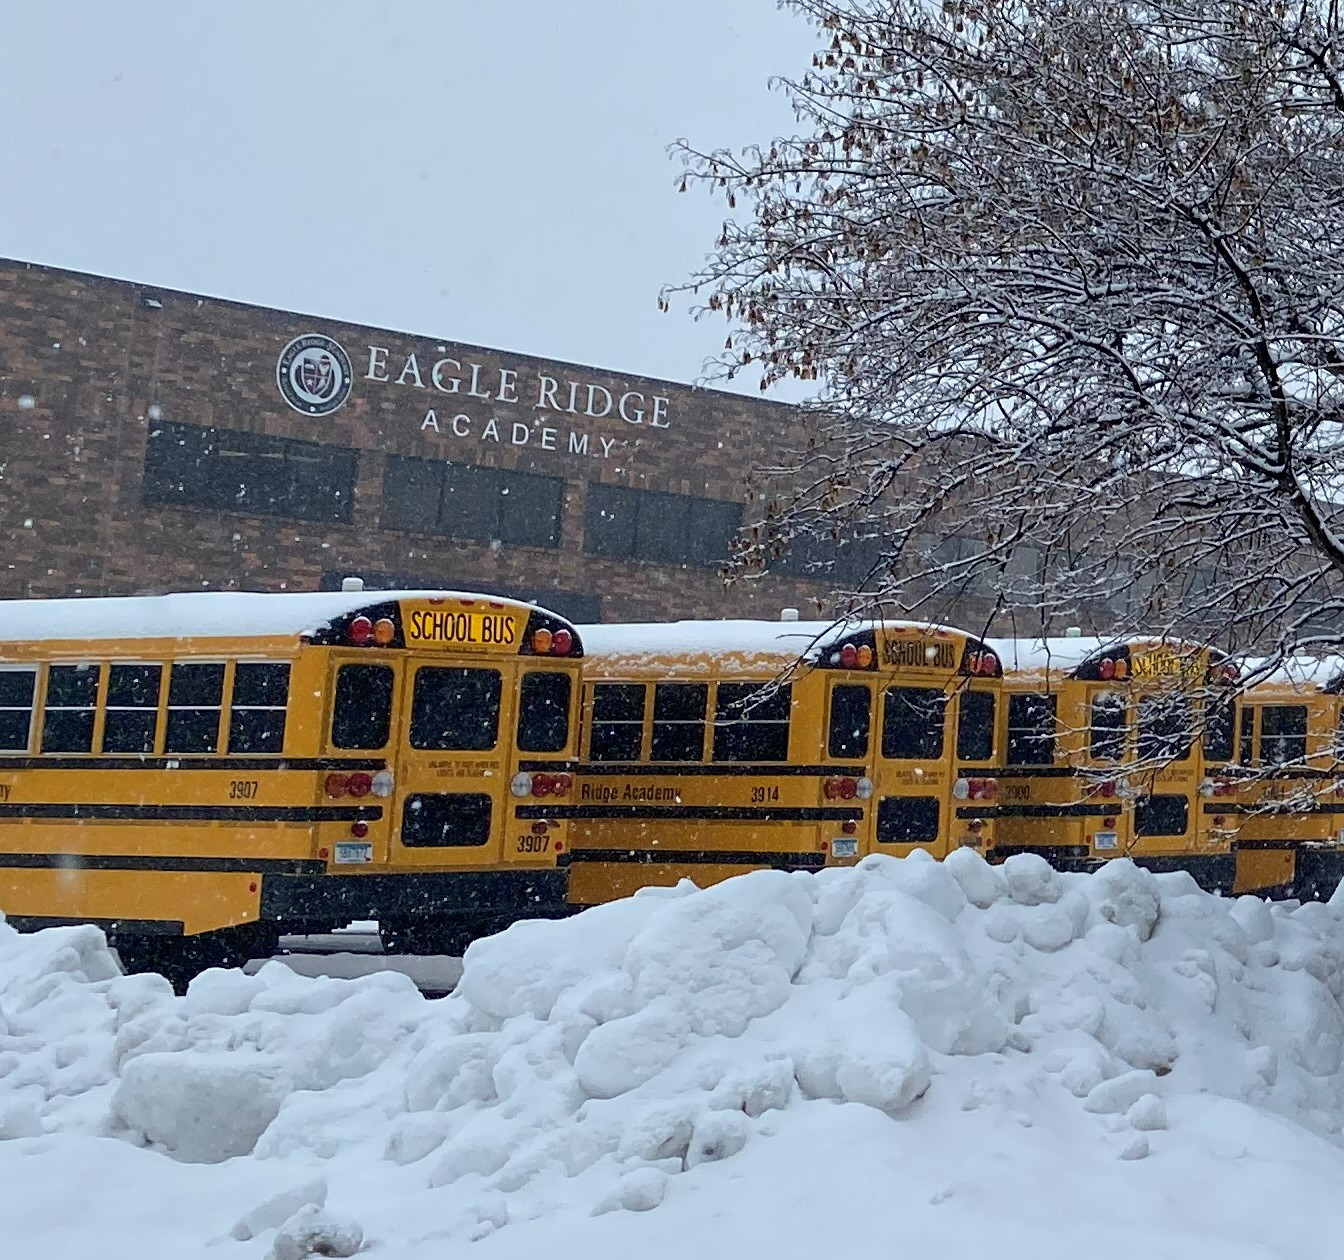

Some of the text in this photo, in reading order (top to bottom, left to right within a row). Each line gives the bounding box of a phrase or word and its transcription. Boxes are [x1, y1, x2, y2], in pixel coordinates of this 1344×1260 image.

[364, 345, 519, 404] EAGLE
[536, 372, 672, 429] RIDGE
[421, 408, 616, 458] ACADEMY
[410, 611, 514, 644] SCHOOL BUS
[229, 780, 259, 799] 3907
[581, 783, 682, 804] Ridge Academy
[751, 785, 779, 803] 3914
[517, 835, 550, 853] 3907
